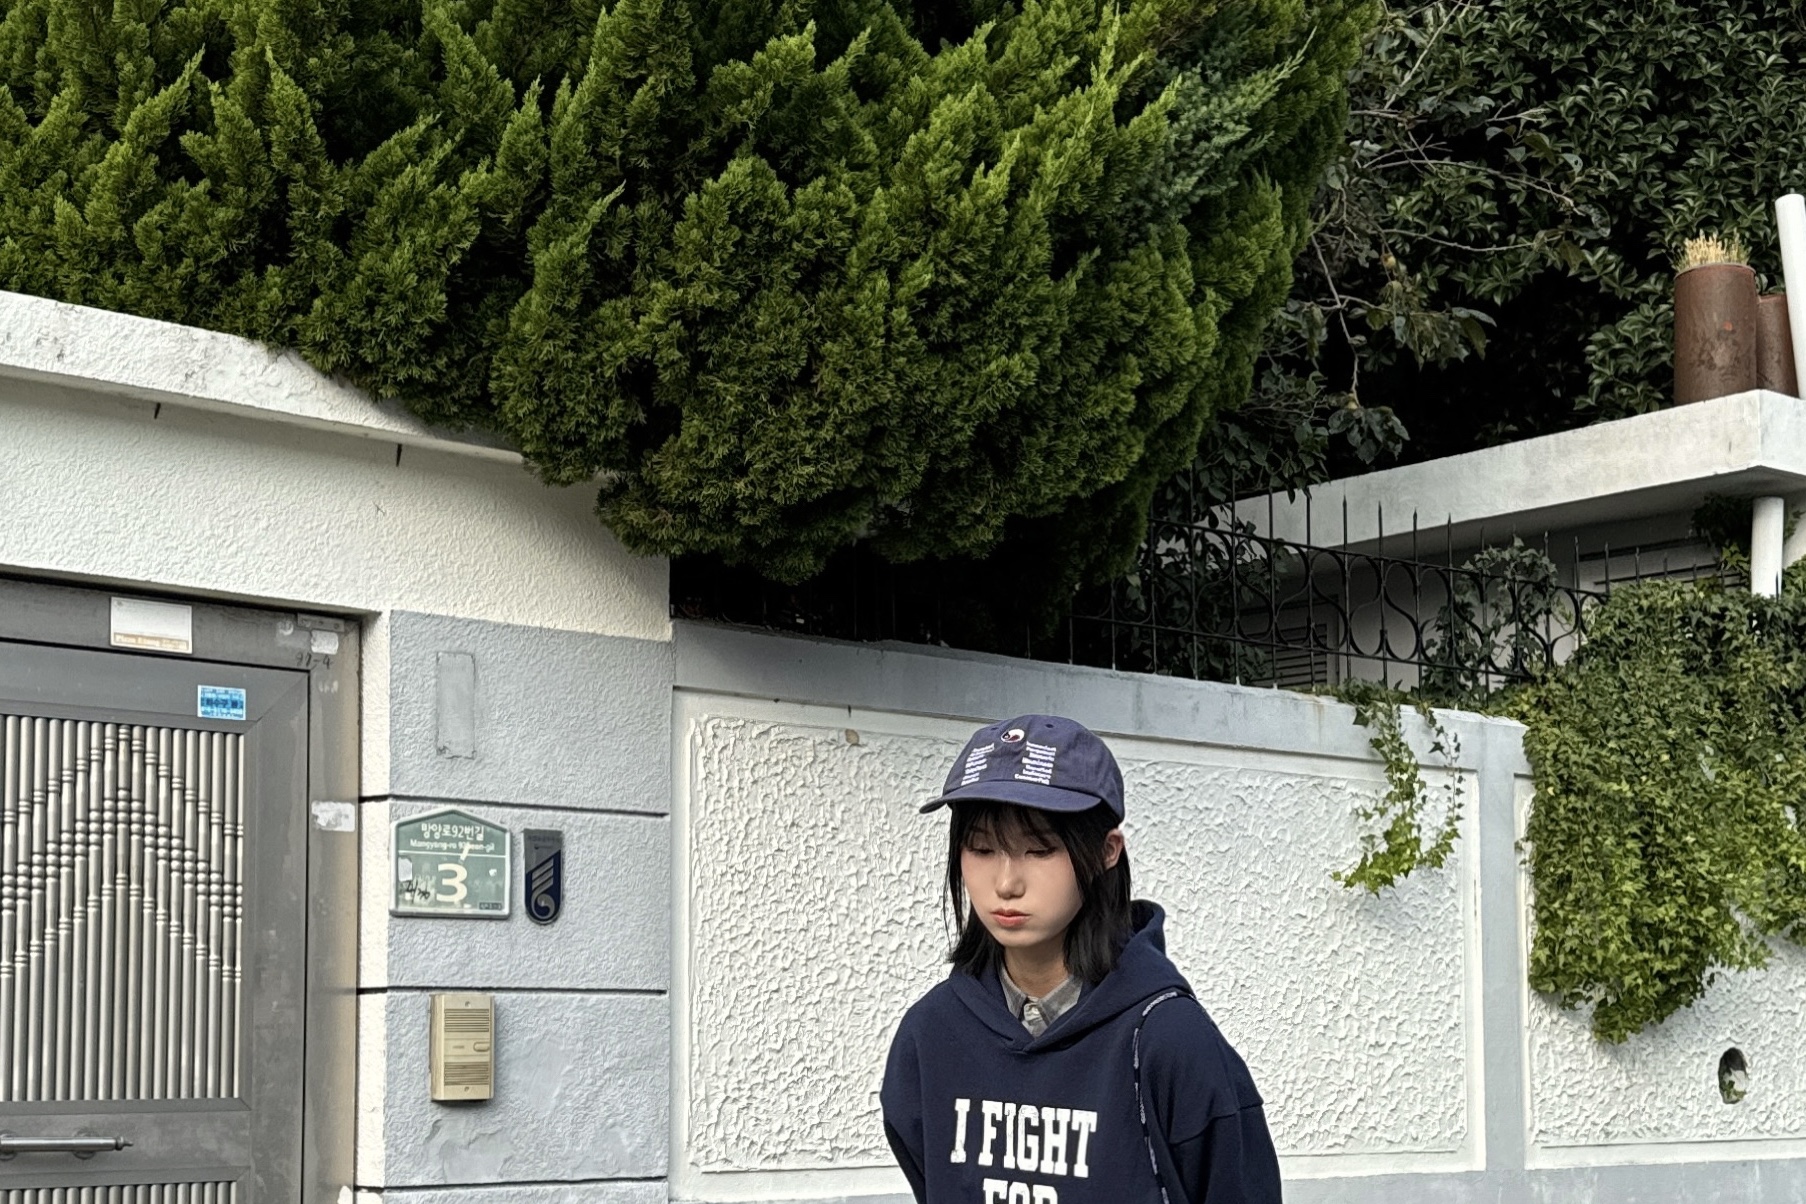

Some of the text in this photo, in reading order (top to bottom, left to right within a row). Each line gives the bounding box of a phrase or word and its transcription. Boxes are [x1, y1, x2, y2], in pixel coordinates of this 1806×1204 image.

[410, 838, 457, 850] Mangyang-ro
[421, 823, 484, 841] 망양로92번길
[436, 863, 468, 902] 3
[950, 1098, 1098, 1178] I FIGHT
